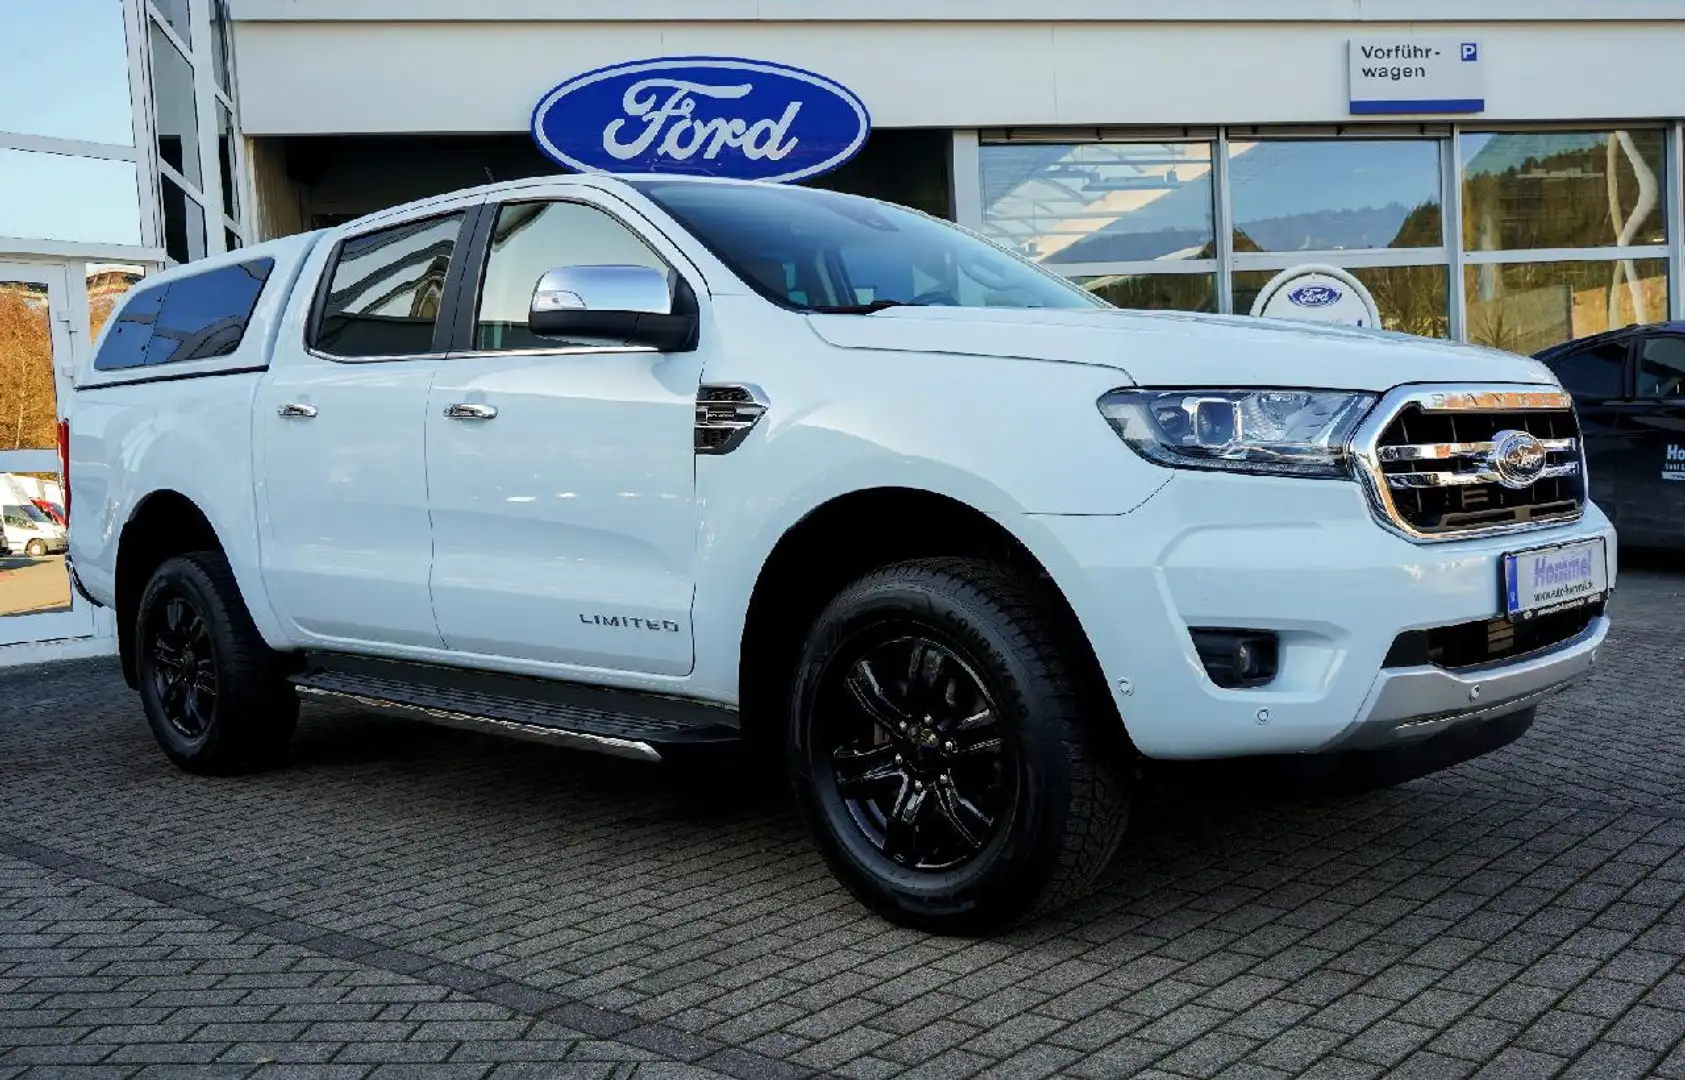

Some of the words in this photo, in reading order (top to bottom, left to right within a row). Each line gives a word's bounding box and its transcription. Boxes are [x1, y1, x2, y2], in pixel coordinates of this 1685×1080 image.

[1361, 44, 1441, 59] Vorführ-
[1462, 44, 1476, 60] P
[1361, 66, 1426, 81] wagen
[602, 78, 803, 160] Ford
[1299, 287, 1331, 304] Ford
[579, 613, 679, 632] LIMITED
